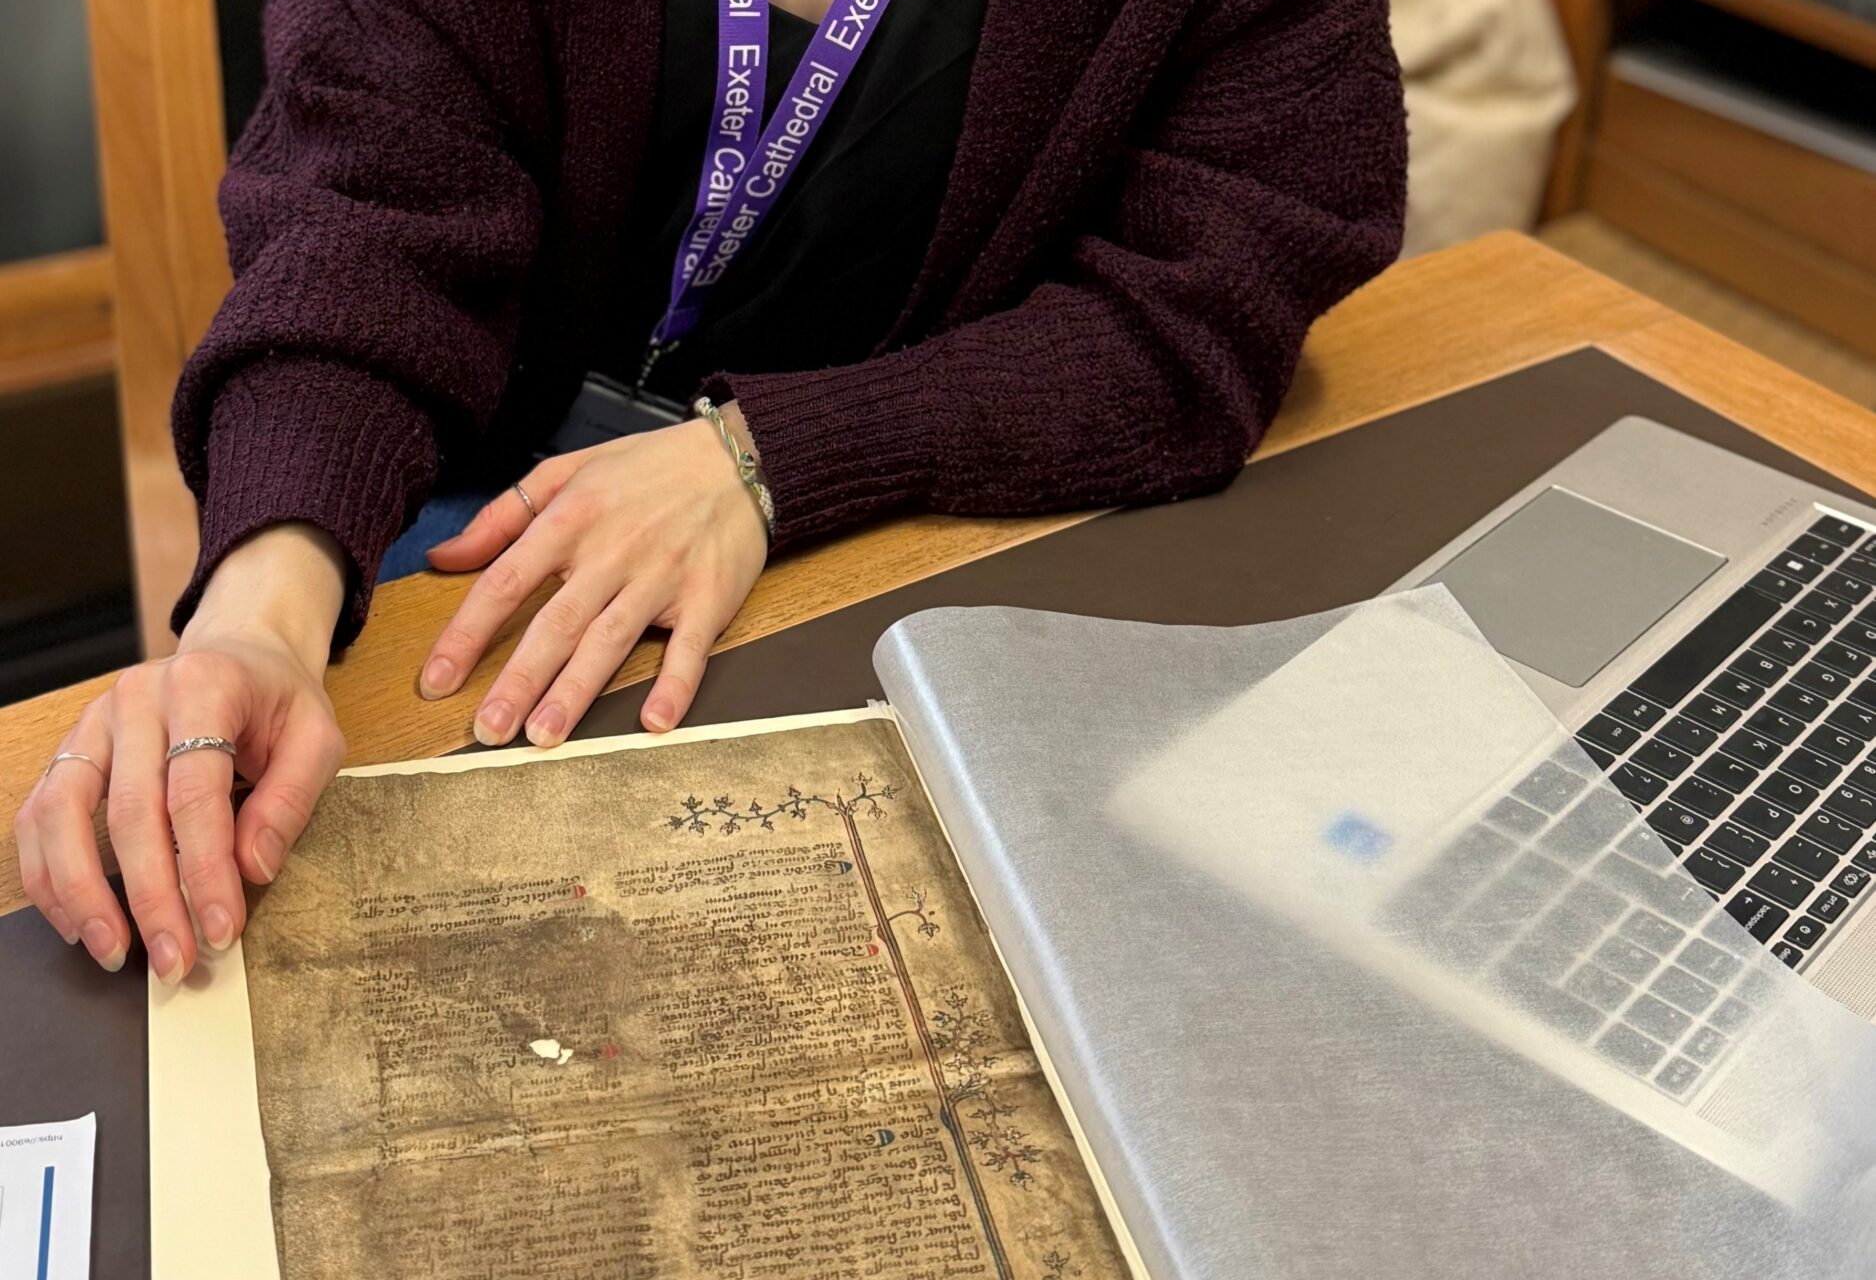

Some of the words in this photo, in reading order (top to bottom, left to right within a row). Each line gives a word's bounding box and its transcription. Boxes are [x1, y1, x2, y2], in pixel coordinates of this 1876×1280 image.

[719, 44, 760, 142] Exeter
[692, 203, 760, 288] Exeter
[746, 61, 839, 200] Cathedral
[1846, 580, 1862, 589] Z
[1824, 599, 1838, 608] X
[1803, 619, 1817, 627] C
[1783, 641, 1796, 649] V
[1846, 651, 1858, 660] F
[1760, 660, 1773, 669] B
[1822, 673, 1835, 682] G
[1736, 682, 1751, 692] N
[1799, 695, 1814, 704] H
[1711, 705, 1726, 715] M
[1778, 717, 1789, 726] J
[1859, 714, 1872, 724] Y
[1753, 740, 1767, 750] K
[1836, 736, 1850, 746] U
[1864, 766, 1876, 775] 8
[1841, 790, 1853, 798] 9
[1768, 808, 1780, 818] P
[1744, 903, 1771, 931] backspac
